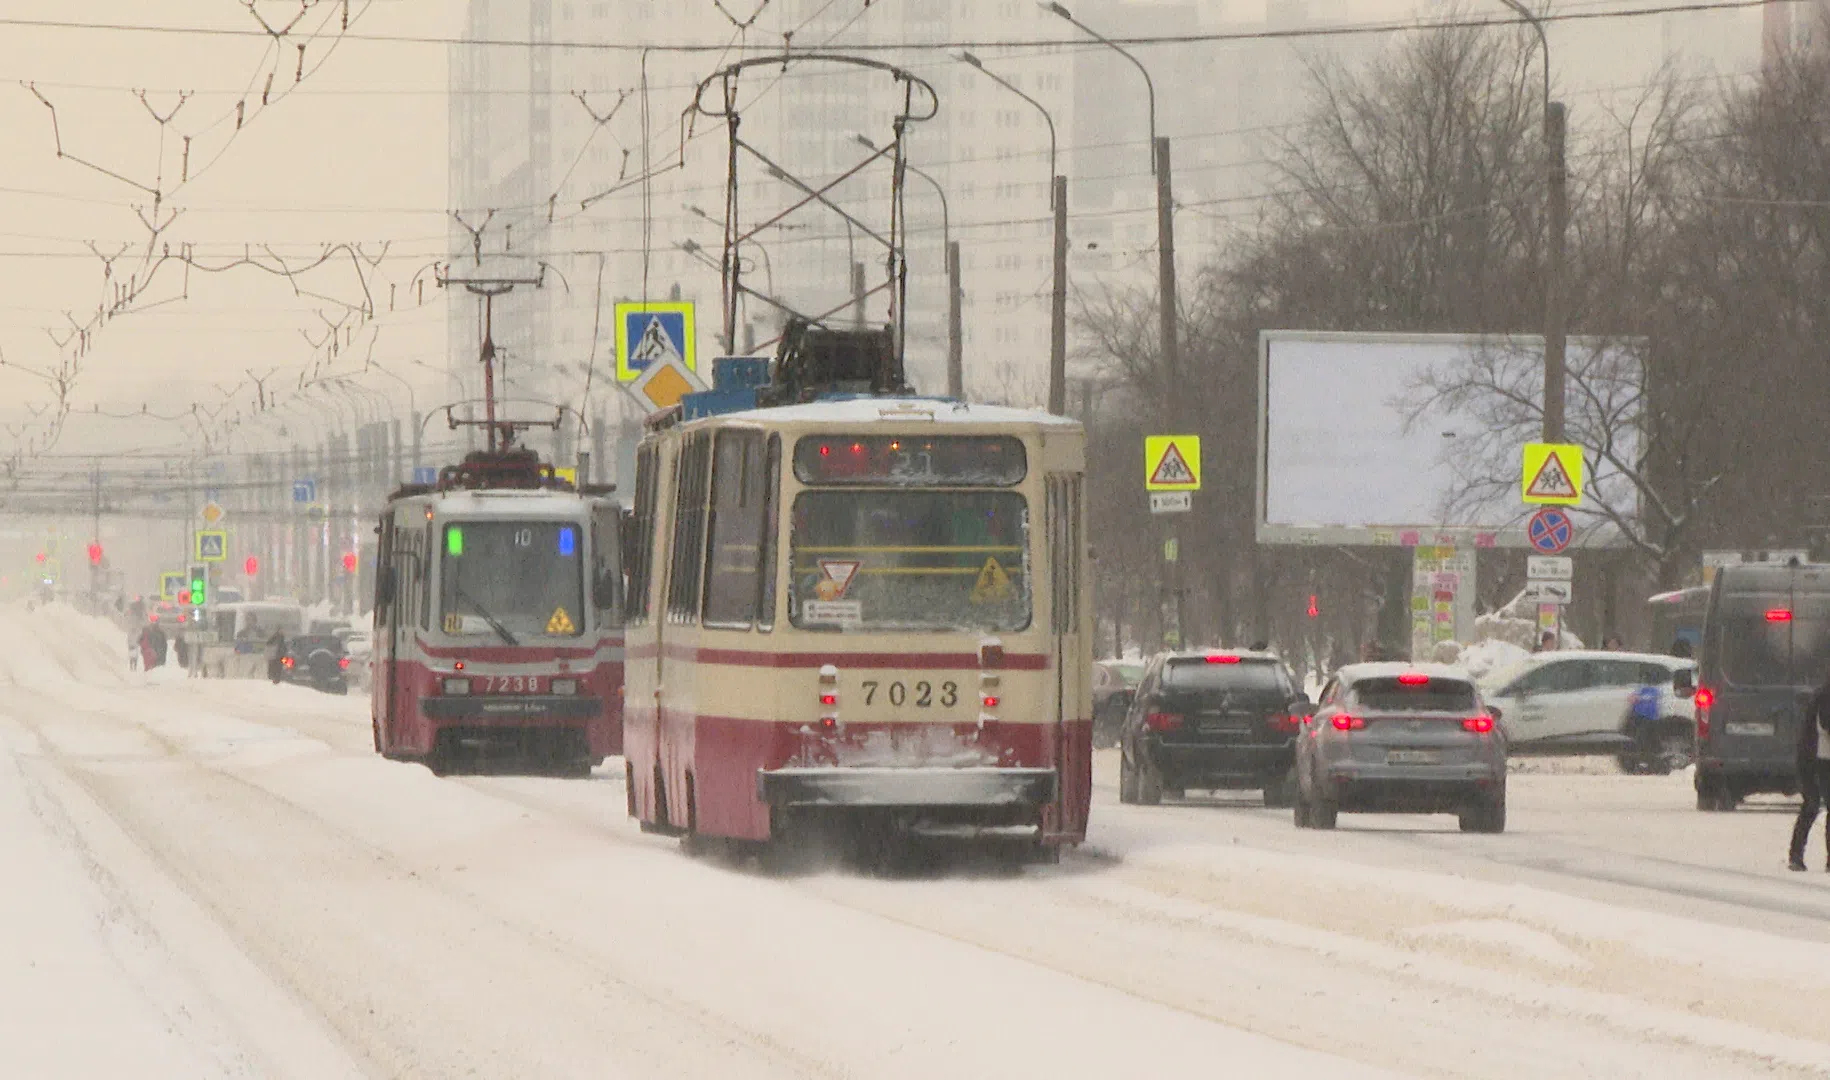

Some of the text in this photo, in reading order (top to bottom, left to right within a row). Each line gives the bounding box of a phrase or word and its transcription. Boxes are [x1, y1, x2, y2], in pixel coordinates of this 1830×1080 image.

[514, 529, 532, 546] 10
[485, 676, 538, 692] 7238
[861, 681, 958, 707] 7023
